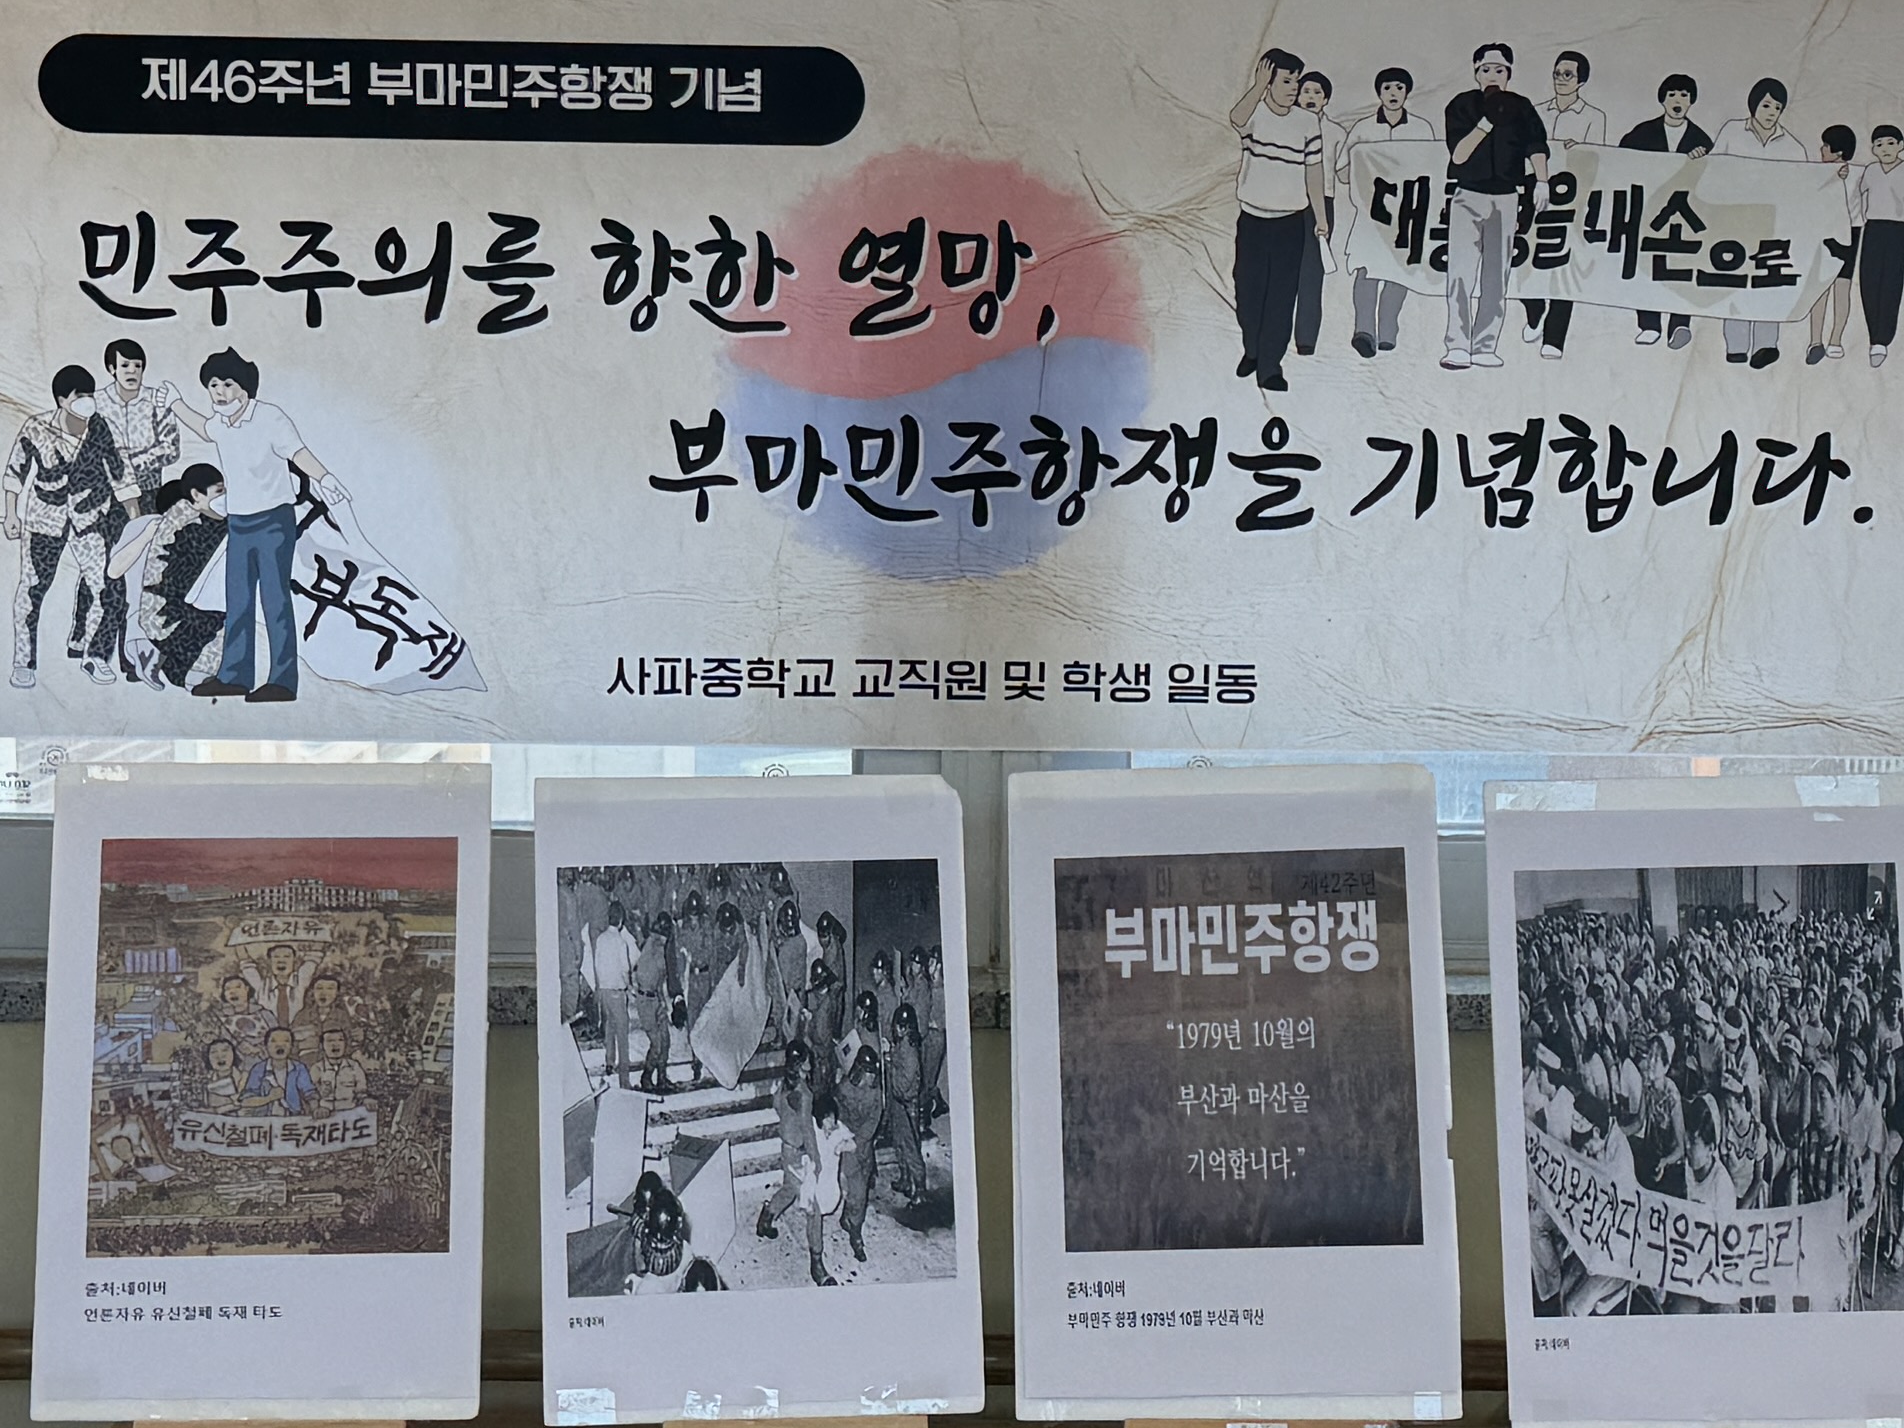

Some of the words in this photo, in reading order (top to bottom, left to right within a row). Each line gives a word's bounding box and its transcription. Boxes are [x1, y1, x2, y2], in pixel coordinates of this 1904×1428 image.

[140, 57, 351, 106] 제46주년
[367, 61, 653, 111] 부마민주항쟁
[669, 67, 762, 113] 기념
[80, 210, 556, 342] 민주주의를
[590, 214, 795, 334] 향한
[838, 216, 1055, 342] 열망,
[648, 408, 1322, 533] 부마민주항쟁을
[1349, 413, 1874, 534] 기념합니다.
[606, 656, 837, 699] 사파중학교
[852, 658, 987, 701] 교직원
[1003, 660, 1046, 702] 및
[1062, 660, 1151, 703] 학생
[1167, 663, 1258, 705] 일동
[1104, 900, 1379, 979] 부마민주항쟁
[1253, 1016, 1315, 1050] 10월의
[1177, 1082, 1241, 1117] 부산과
[1247, 1081, 1311, 1115] 마산을
[217, 1305, 248, 1321] 독재
[252, 1304, 284, 1321] 타도
[1139, 1309, 1176, 1328] 1979년
